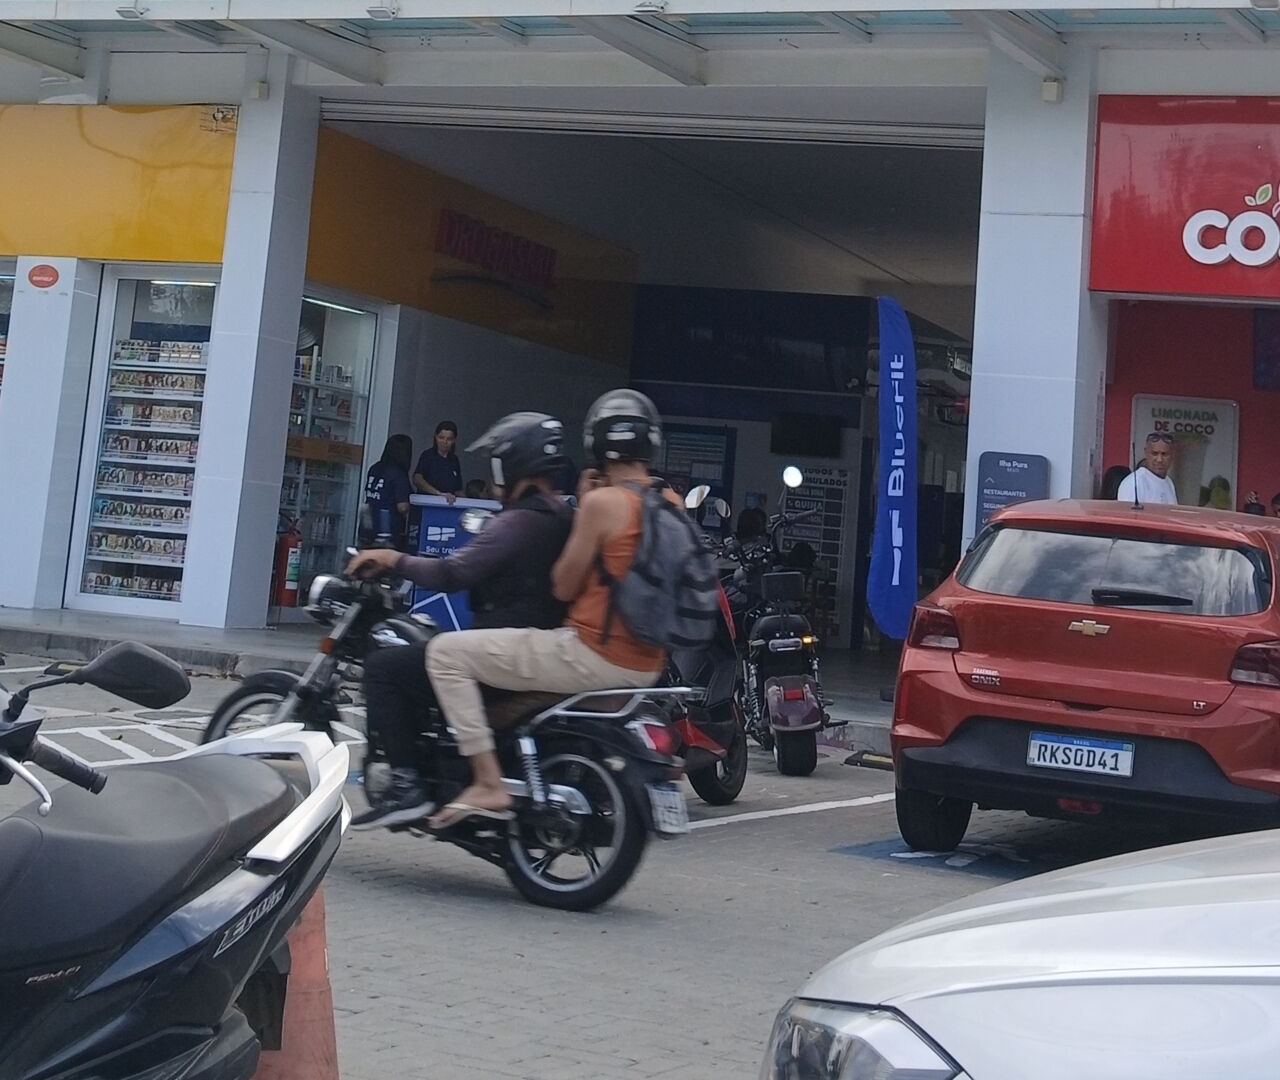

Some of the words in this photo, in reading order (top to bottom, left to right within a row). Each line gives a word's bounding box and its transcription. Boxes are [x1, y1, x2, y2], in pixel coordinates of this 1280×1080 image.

[1151, 408, 1219, 422] LIMONADA
[1154, 421, 1169, 432] DE
[1173, 422, 1215, 436] COCO
[971, 675, 1001, 686] ONIX
[1193, 701, 1207, 710] LT
